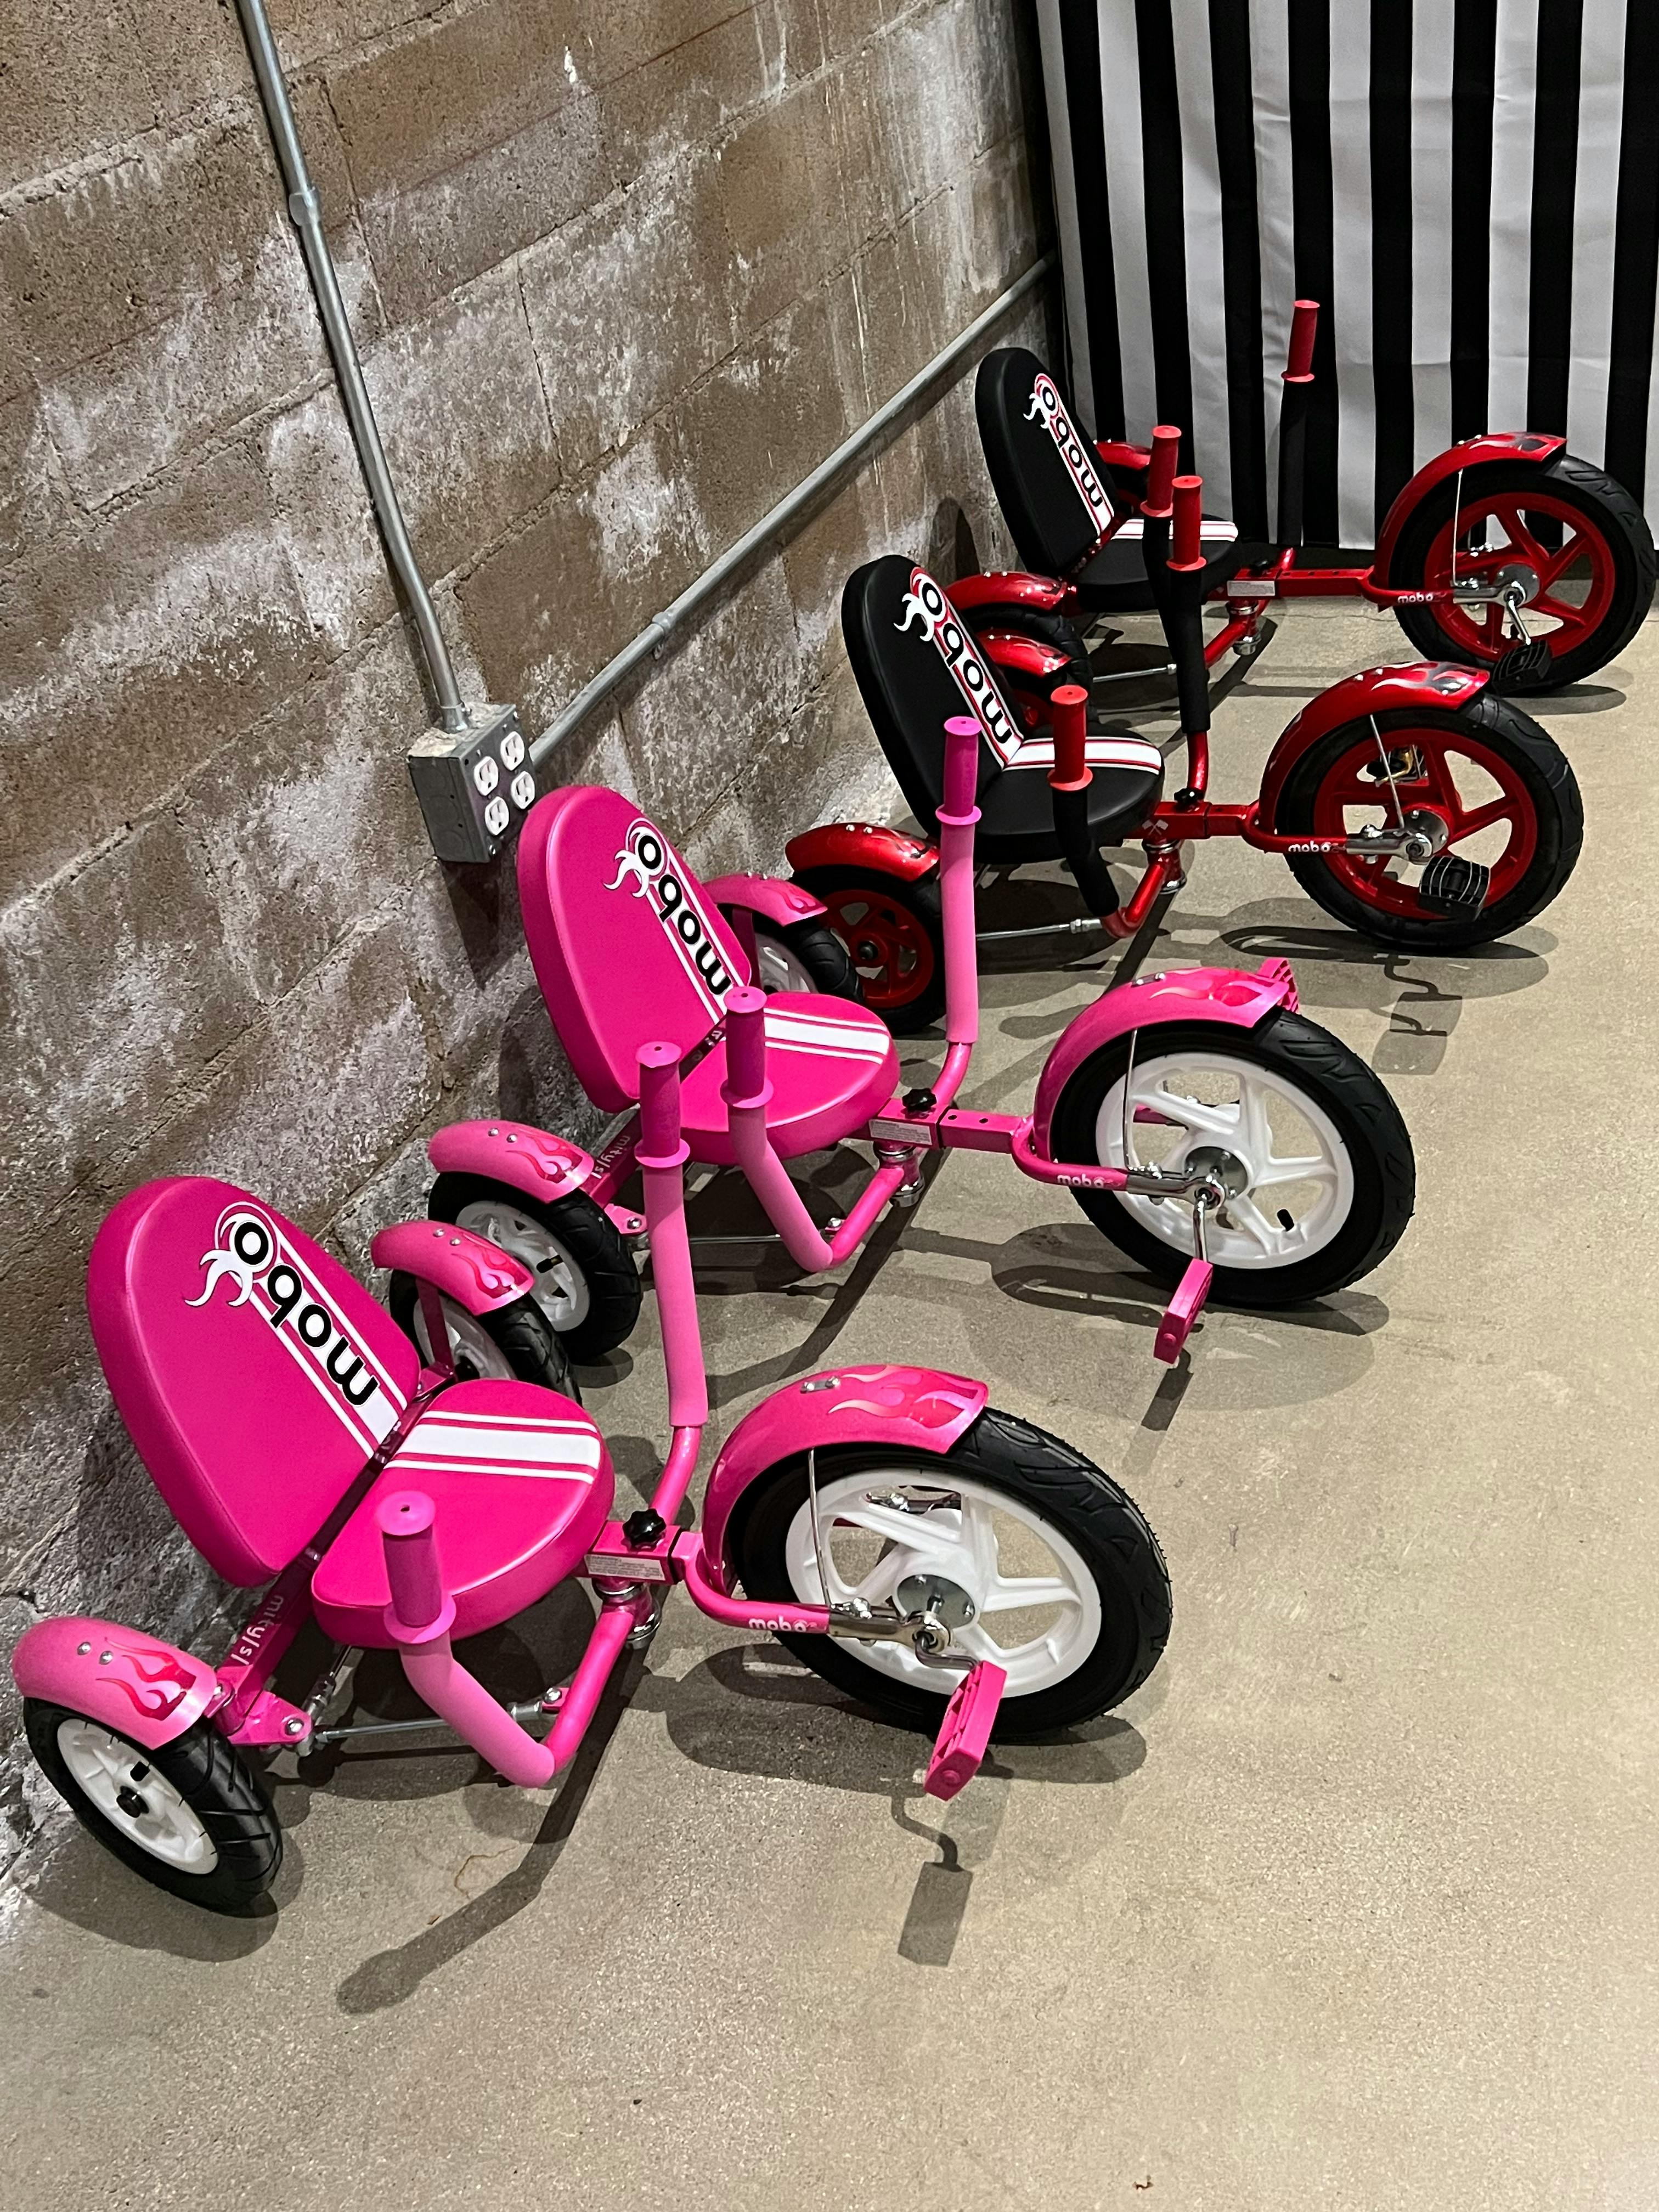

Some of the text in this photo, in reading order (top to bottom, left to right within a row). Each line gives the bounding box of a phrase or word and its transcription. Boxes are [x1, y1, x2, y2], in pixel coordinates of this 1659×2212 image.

[1043, 386, 1103, 507] mobo
[1398, 592, 1434, 603] mobo
[922, 582, 1014, 743] mobo
[1288, 840, 1330, 852] mobo
[637, 834, 731, 995] mobo
[1057, 1173, 1104, 1188] mobo
[234, 1221, 379, 1406] mobo
[748, 1615, 806, 1632] mobo
